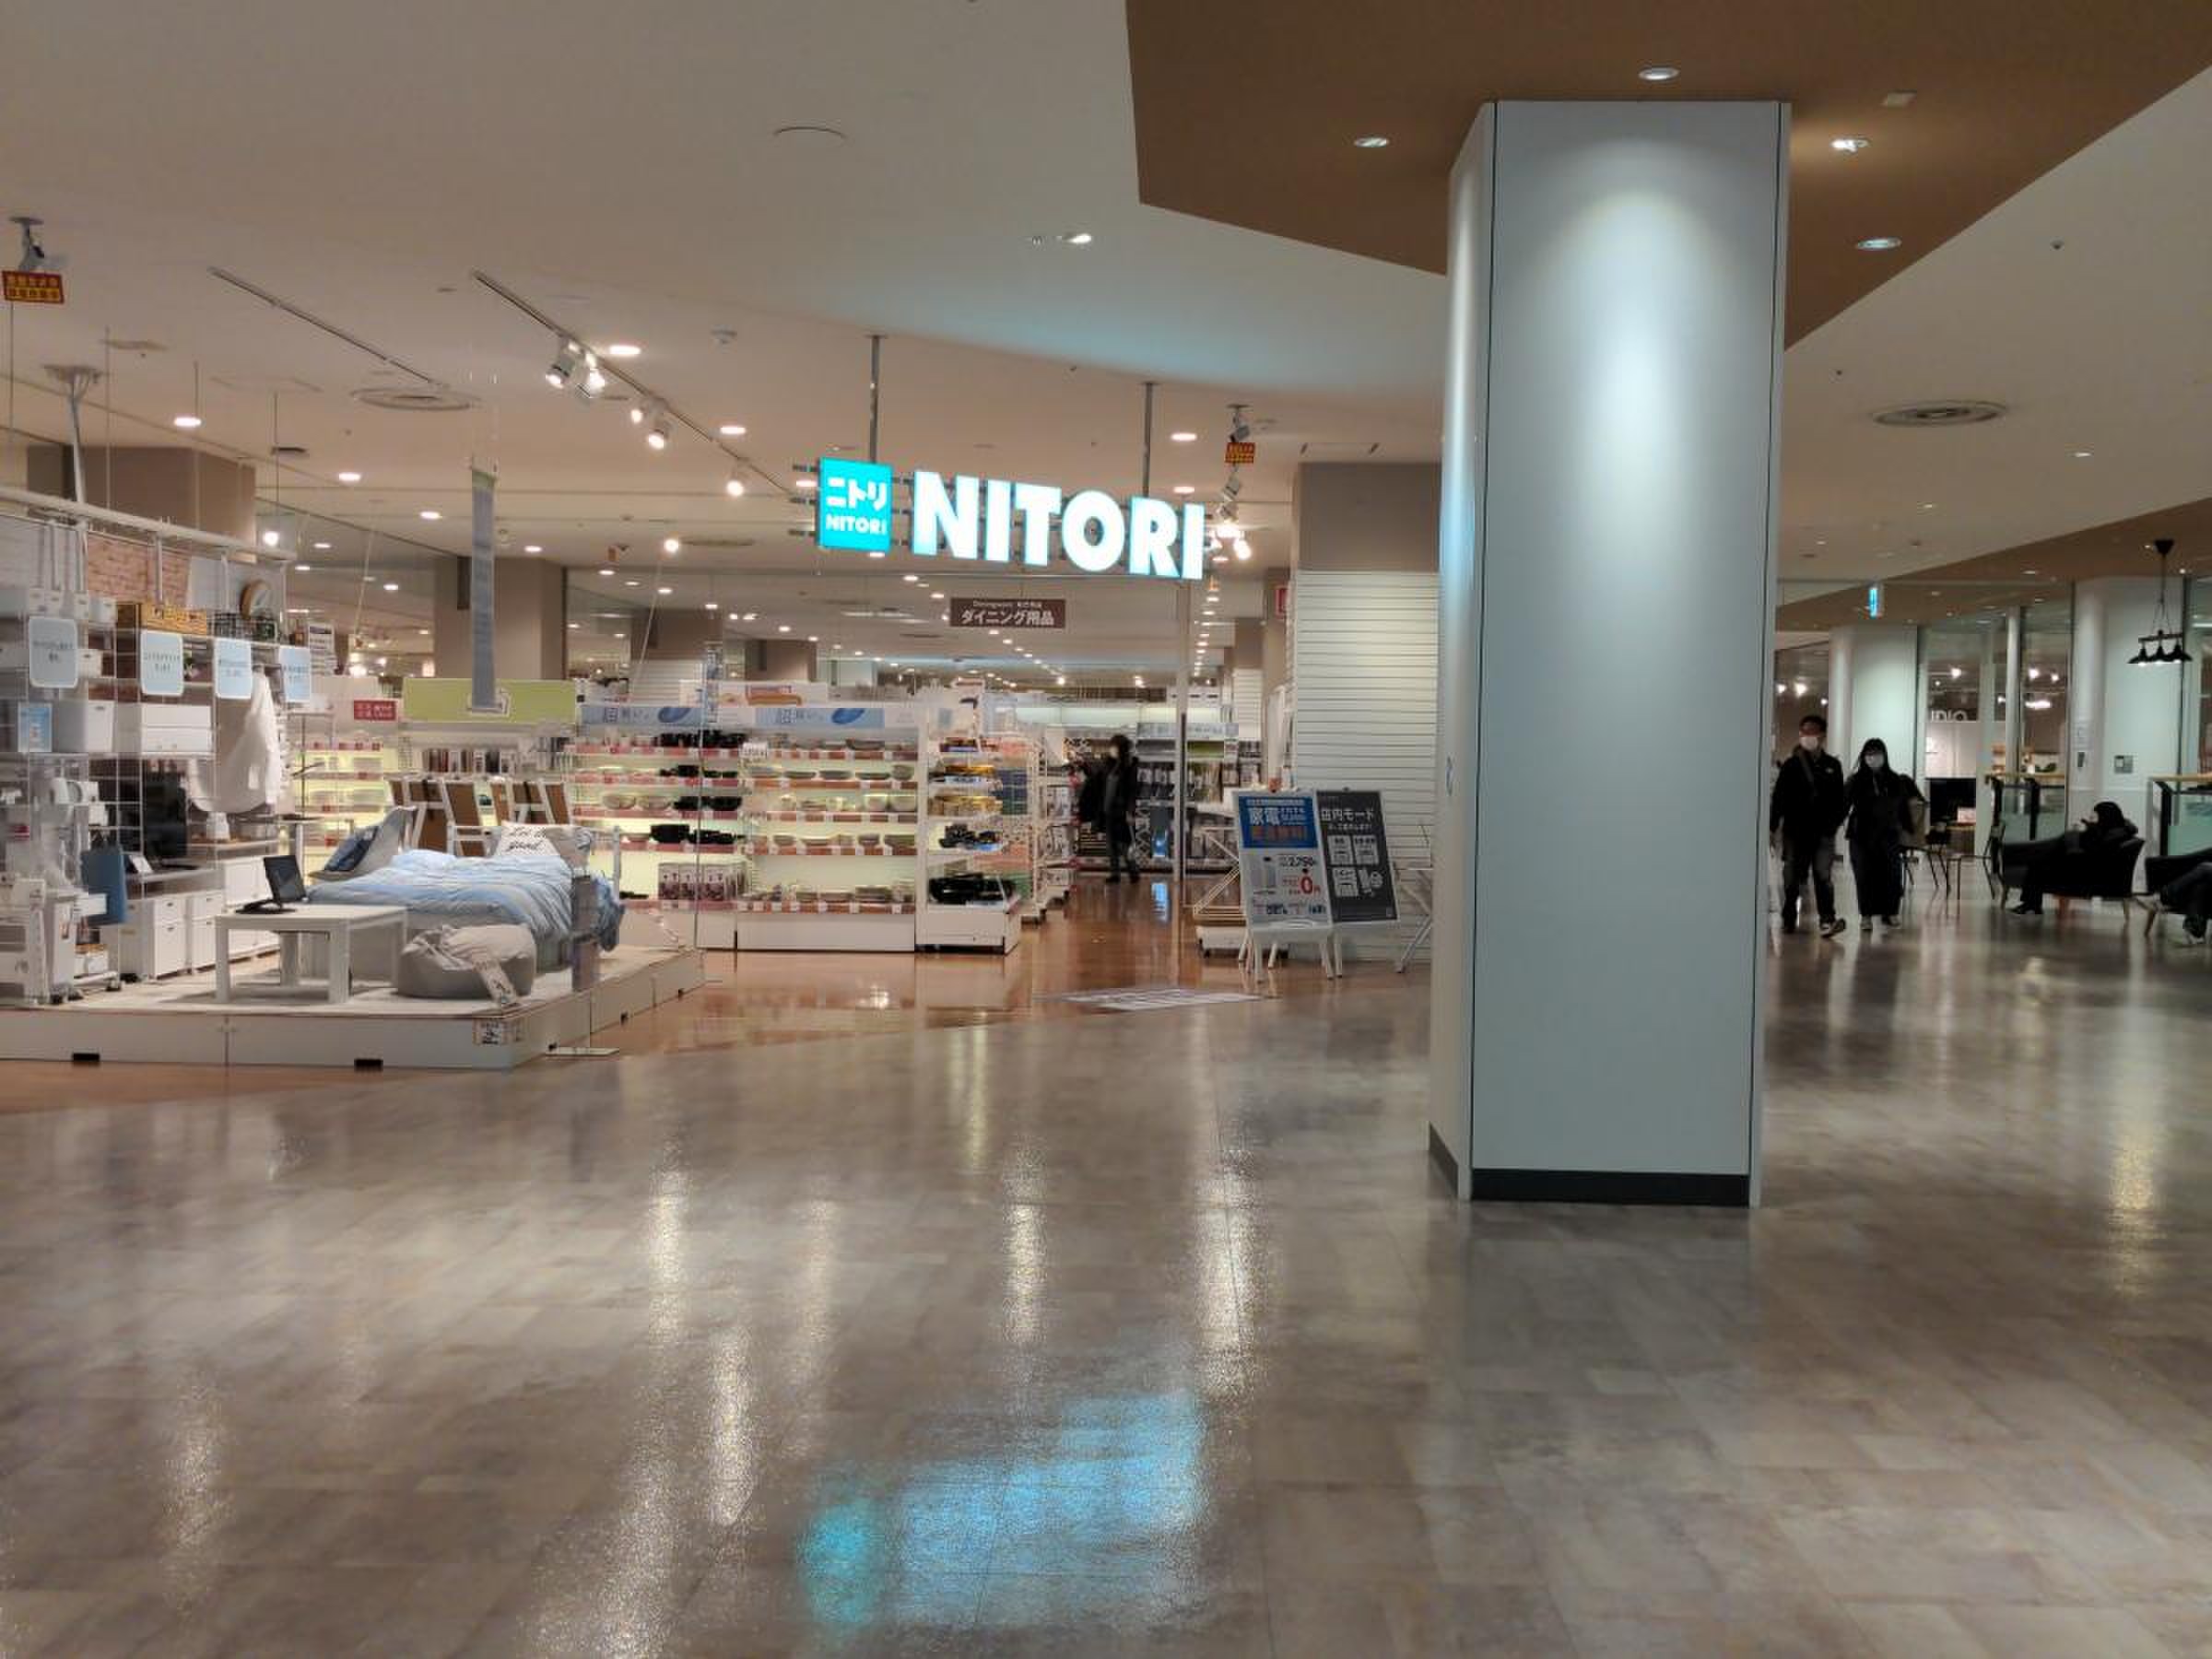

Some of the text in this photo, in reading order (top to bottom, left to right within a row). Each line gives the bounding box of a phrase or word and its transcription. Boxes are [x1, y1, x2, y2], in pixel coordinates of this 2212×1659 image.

[826, 477, 888, 512] ニトリ
[826, 513, 888, 535] NITORI
[912, 470, 1206, 580] NITORI
[960, 609, 1054, 625] ダイニング用品
